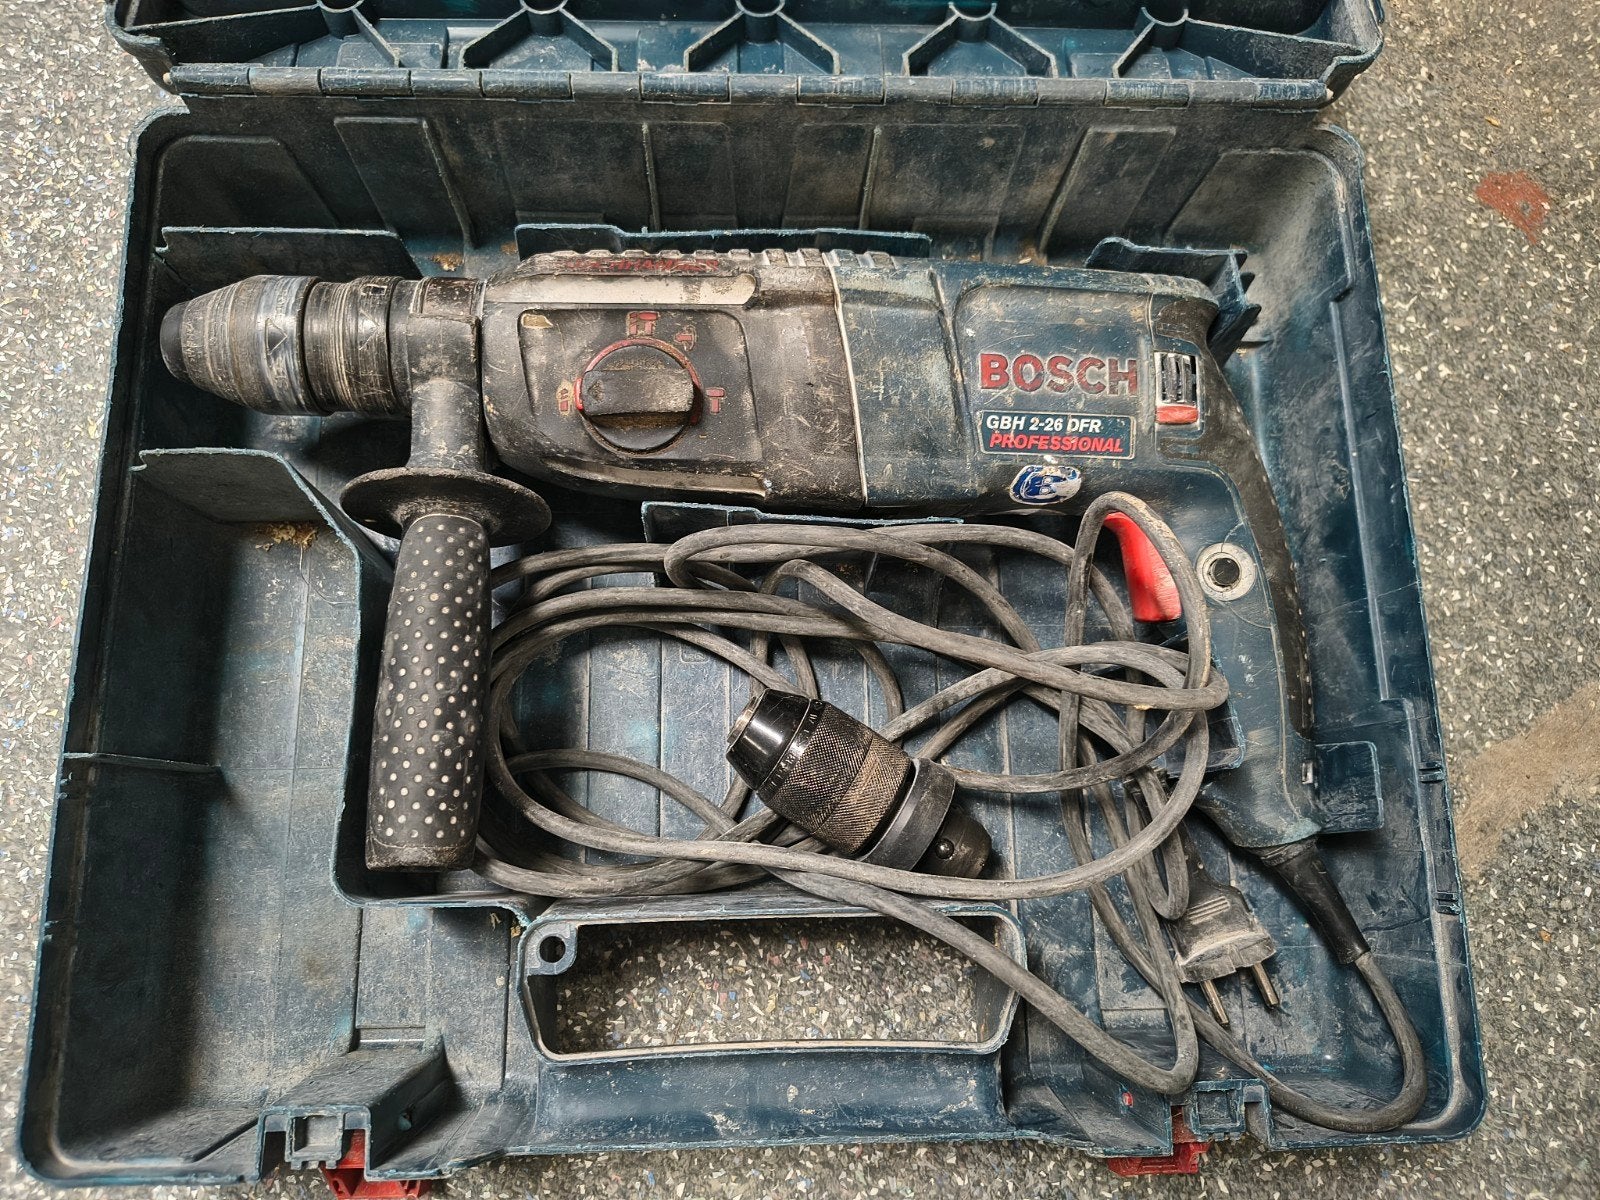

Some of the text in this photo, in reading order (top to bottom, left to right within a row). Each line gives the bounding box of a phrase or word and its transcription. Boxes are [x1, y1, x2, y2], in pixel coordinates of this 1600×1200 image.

[979, 353, 1139, 395] BOSCH
[986, 415, 1102, 433] GBH 2-26 DFR
[989, 432, 1124, 453] PROFESSIONAL
